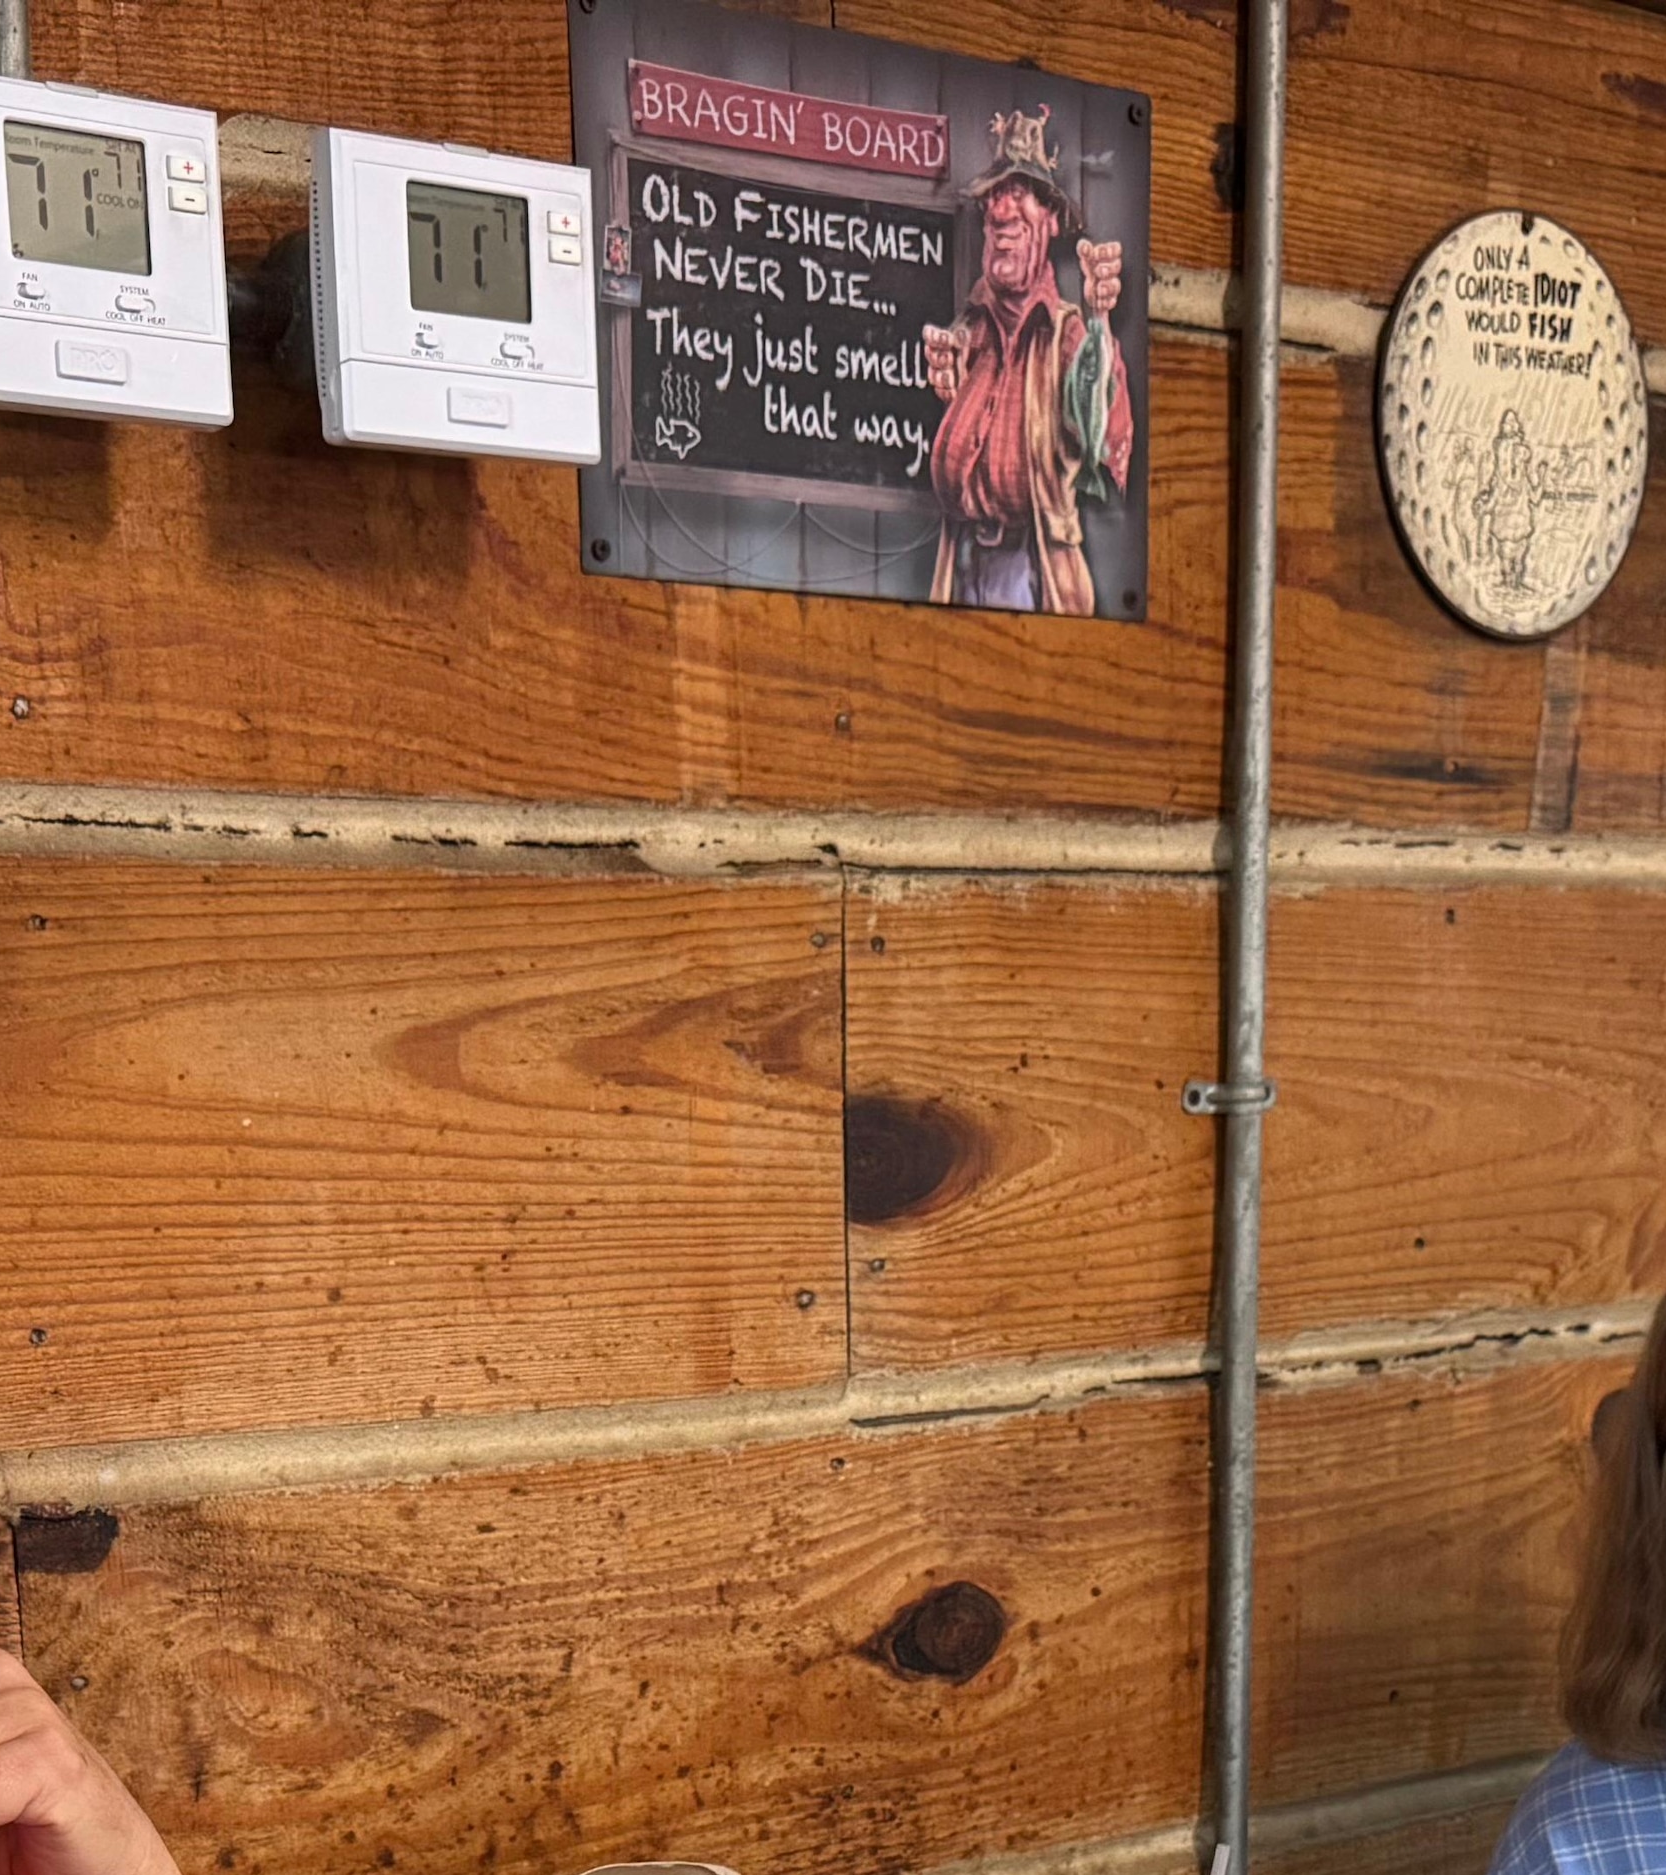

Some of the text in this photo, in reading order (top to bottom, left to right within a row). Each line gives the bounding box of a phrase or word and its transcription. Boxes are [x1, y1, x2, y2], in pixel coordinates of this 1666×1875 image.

[34, 137, 96, 155] Temperature
[824, 111, 944, 168] BOARD
[642, 174, 943, 267] OLD FISHERMEN
[21, 272, 38, 282] FAN
[654, 239, 785, 302] NEVER
[1473, 246, 1531, 273] ONLY A
[29, 301, 51, 311] AUTO
[119, 284, 149, 296] SYSTEM
[1456, 271, 1582, 310] COMPLETE IDIOT
[104, 311, 127, 321] COOL
[146, 316, 166, 326] HEAT
[1466, 310, 1574, 343] WOULD FISH
[647, 307, 927, 390] They just smell
[1473, 341, 1593, 379] IN THIS WEATHER!
[764, 383, 930, 477] that way.
